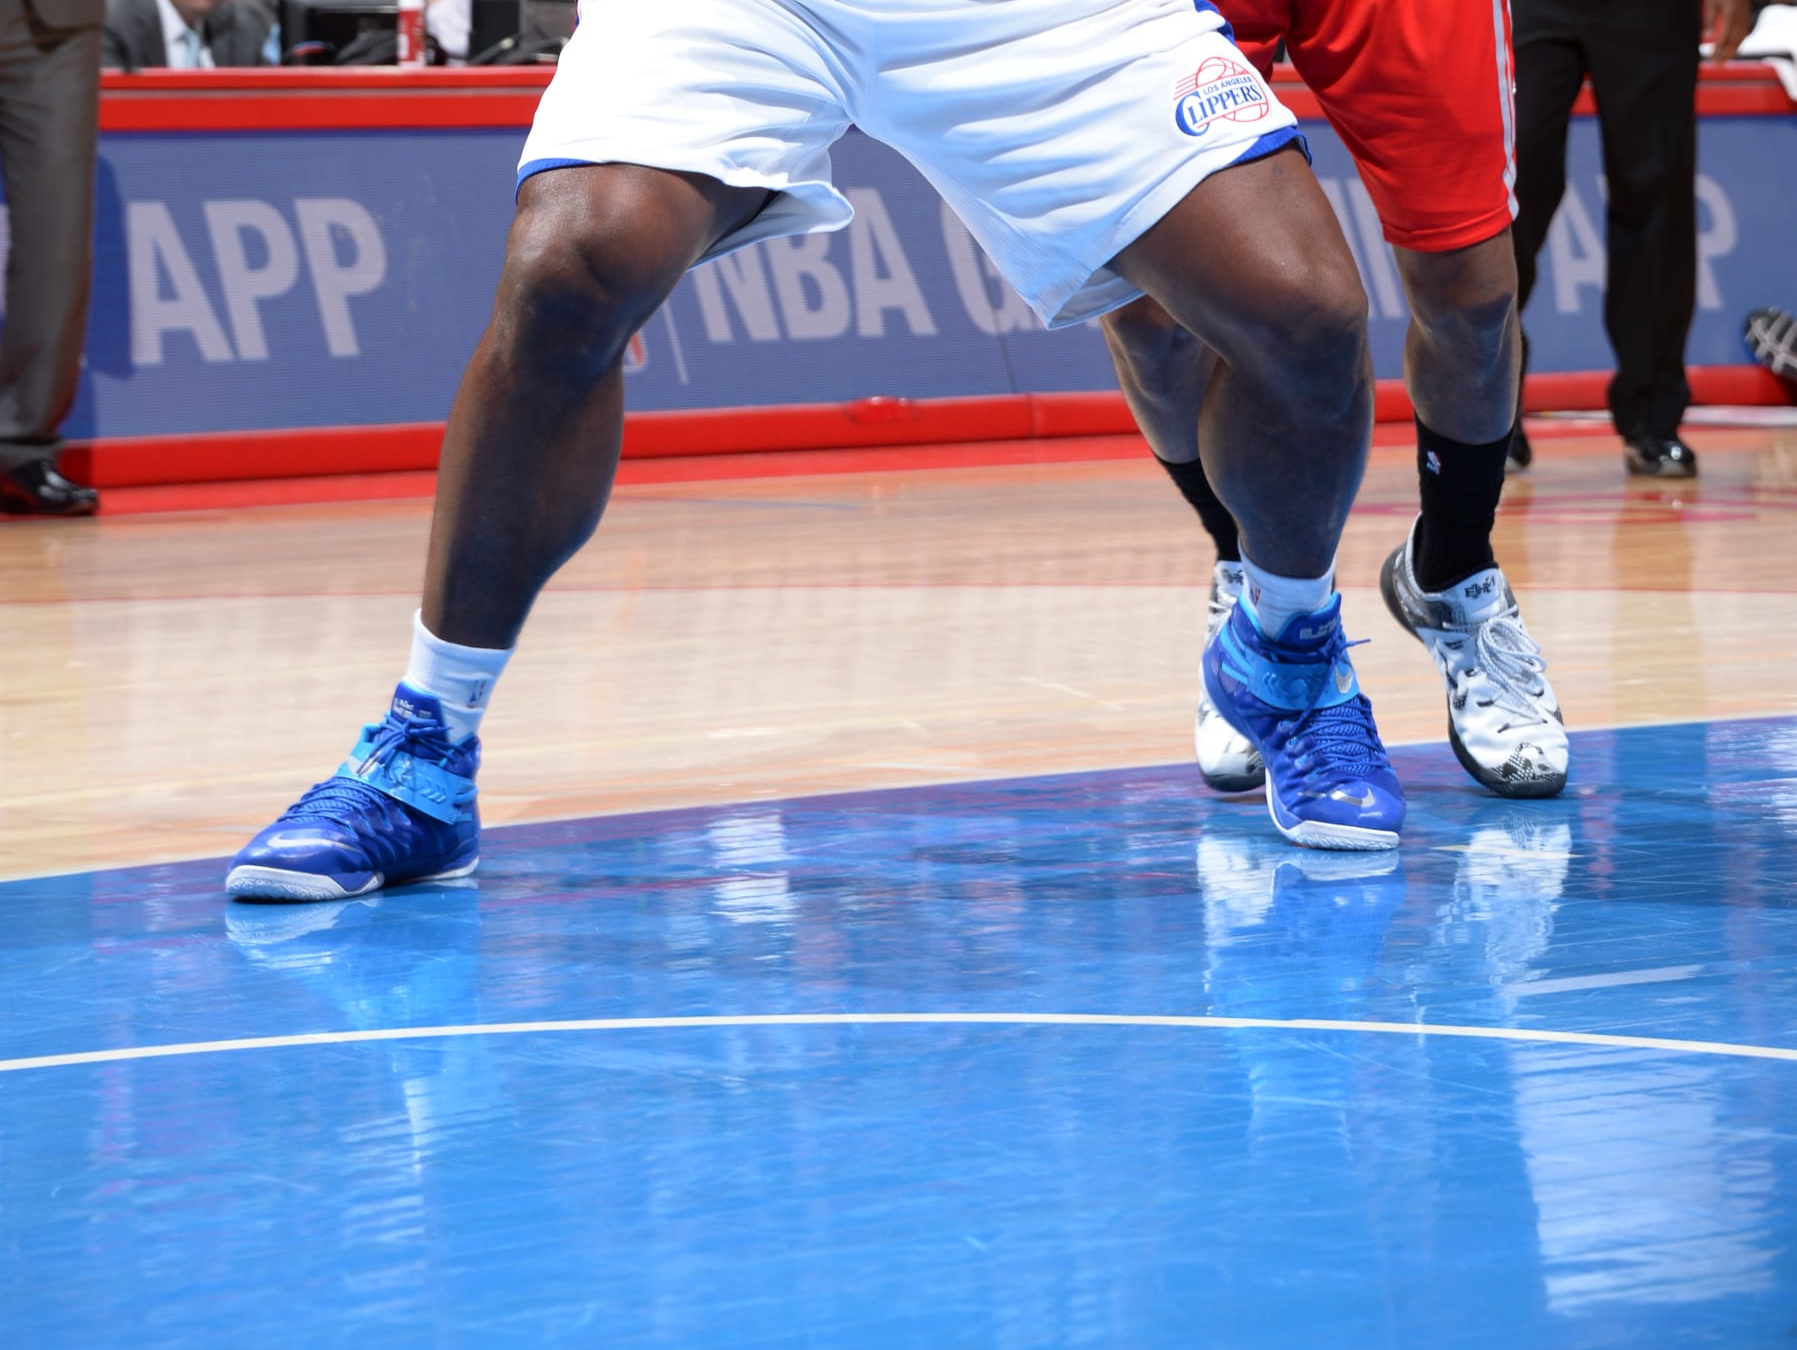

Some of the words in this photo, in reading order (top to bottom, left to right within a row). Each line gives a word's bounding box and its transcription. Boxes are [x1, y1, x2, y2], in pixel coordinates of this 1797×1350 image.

[1203, 84, 1219, 95] LOS
[1221, 76, 1252, 89] ANGELES
[126, 197, 389, 366] APP
[692, 187, 938, 343] NBA
